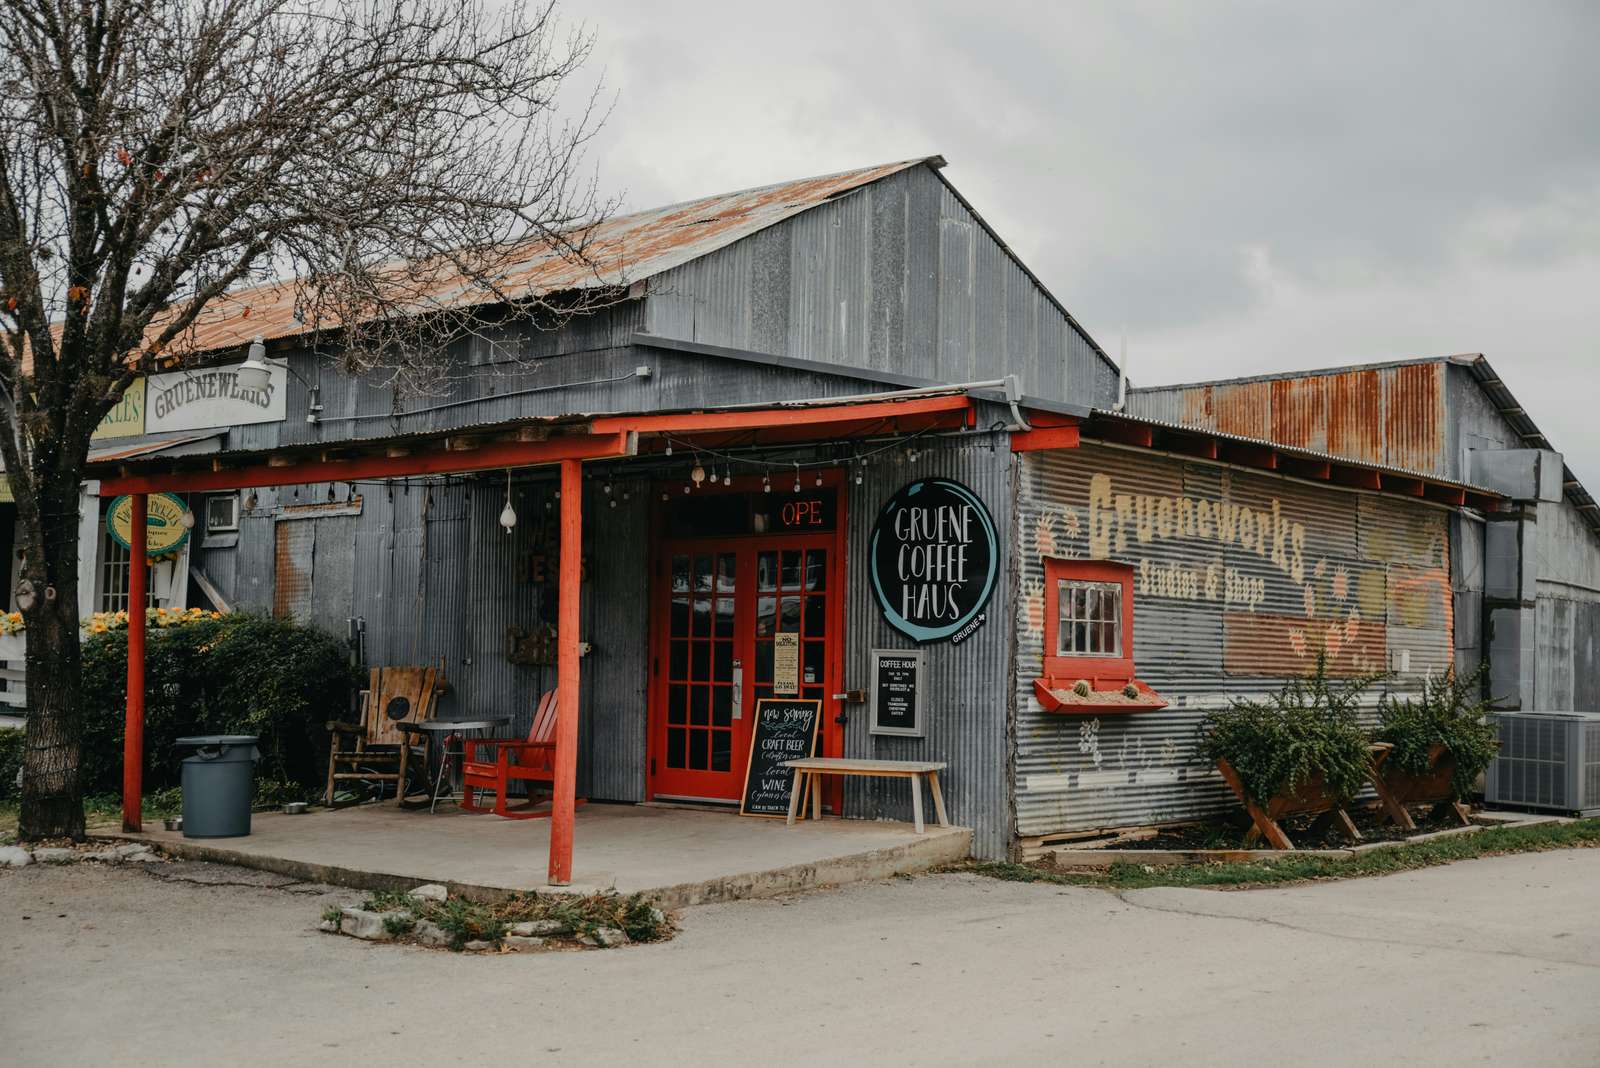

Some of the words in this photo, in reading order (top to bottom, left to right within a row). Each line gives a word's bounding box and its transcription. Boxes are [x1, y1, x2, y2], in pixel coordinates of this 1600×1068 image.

[894, 504, 973, 544] GRUENE
[1089, 473, 1304, 584] Gruenewerks
[898, 543, 969, 582] COFFEE
[902, 583, 962, 620] HAUS
[1205, 564, 1218, 600] &
[1225, 567, 1264, 612] Shops
[952, 618, 980, 643] GRUENE
[880, 660, 901, 668] COFFEE
[761, 739, 784, 750] CRAFT
[785, 739, 805, 751] BEER
[761, 778, 787, 791] WINE
